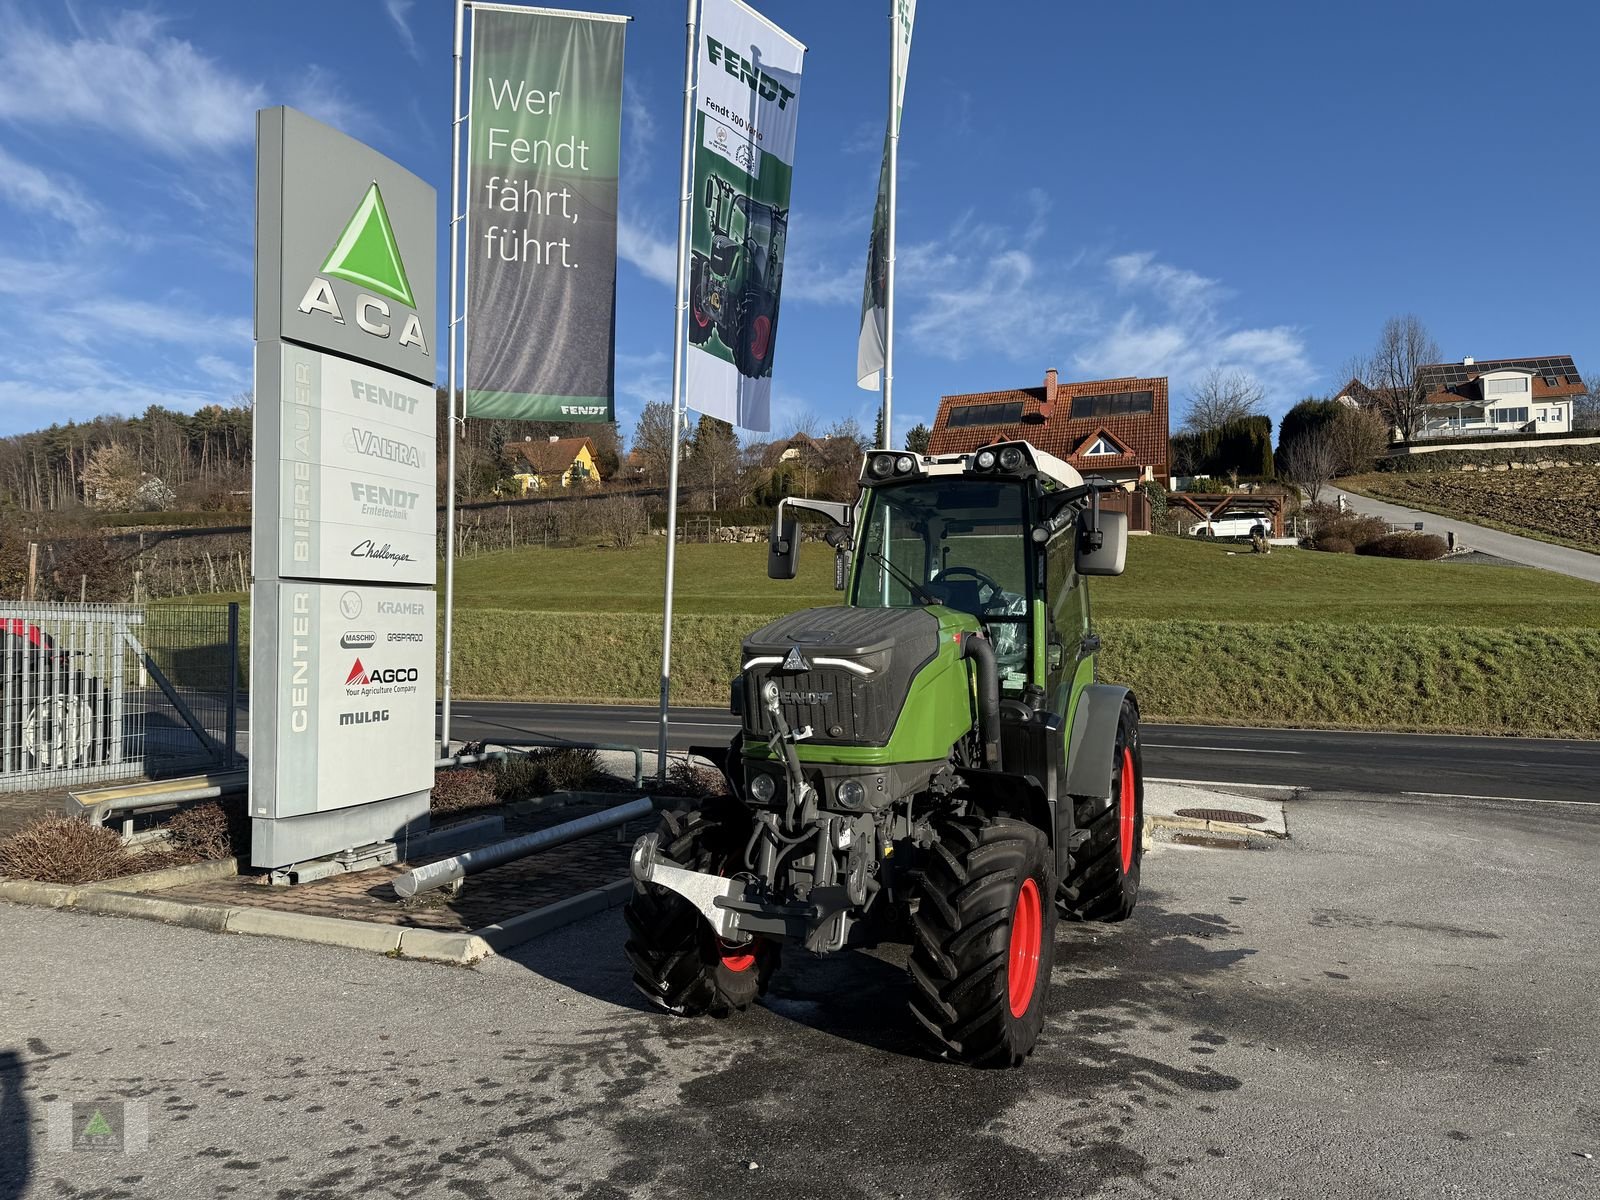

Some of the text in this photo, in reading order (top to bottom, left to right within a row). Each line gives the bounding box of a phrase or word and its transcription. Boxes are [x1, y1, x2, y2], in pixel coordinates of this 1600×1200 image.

[706, 34, 796, 112] FENDT
[488, 77, 561, 115] Wer
[706, 96, 763, 141] Fendt 300 Vario
[488, 128, 590, 171] Fendt
[485, 176, 579, 225] fährt,
[484, 226, 579, 269] führt.
[297, 276, 430, 357] ACA
[350, 379, 419, 415] FENDT
[560, 405, 608, 415] FENDT
[351, 427, 420, 469] VALTRA
[350, 482, 420, 510] FENDT
[361, 503, 409, 520] Erntetechnik
[350, 539, 417, 567] Challenger
[377, 601, 425, 616] KRAMER
[345, 634, 375, 642] MASCHIO
[291, 591, 309, 733] CENTER
[370, 668, 418, 684] AGCO
[345, 685, 417, 697] Your Agriculture Company
[778, 690, 833, 705] ENDT
[339, 709, 390, 726] MULAG
